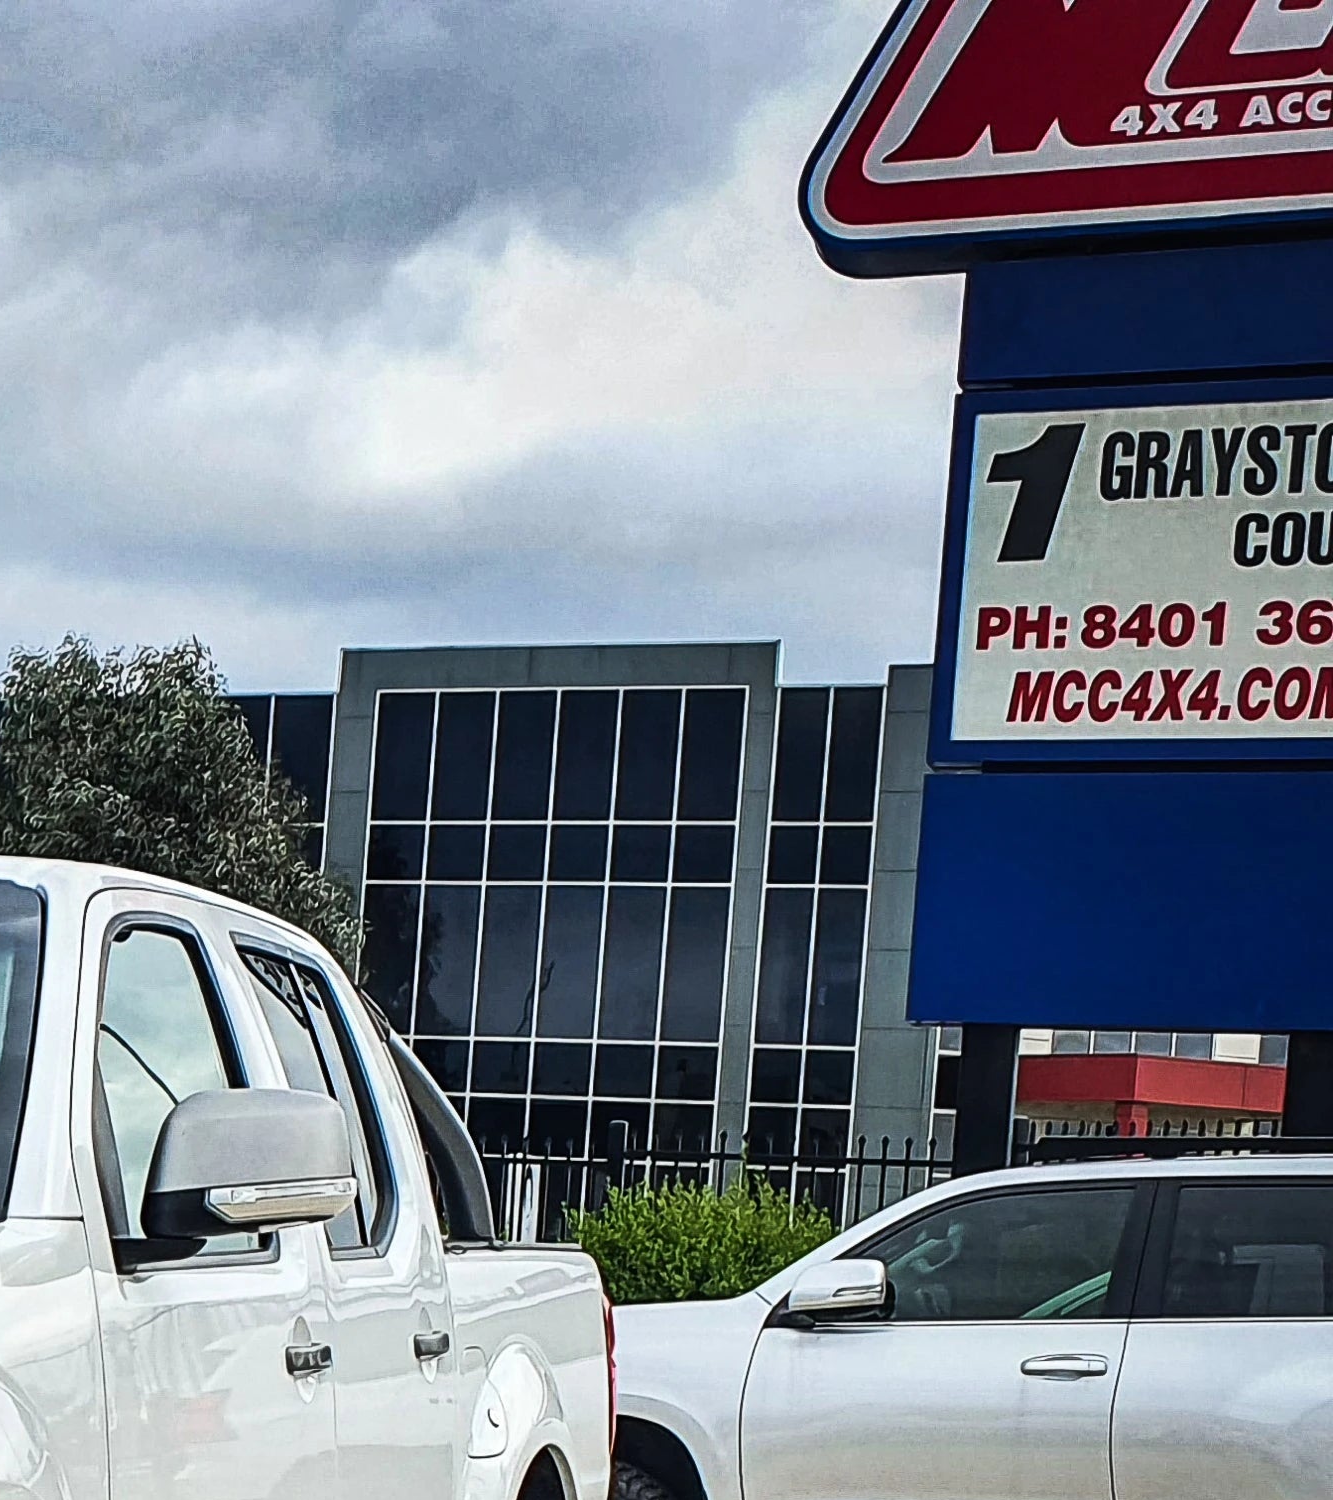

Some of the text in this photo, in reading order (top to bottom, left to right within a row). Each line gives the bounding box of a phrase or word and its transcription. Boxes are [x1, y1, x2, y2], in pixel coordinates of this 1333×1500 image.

[1110, 90, 1333, 136] 4X4 ACC
[986, 422, 1087, 564] 1
[1233, 511, 1333, 568] COU
[976, 599, 1333, 651] PH: 8401 36
